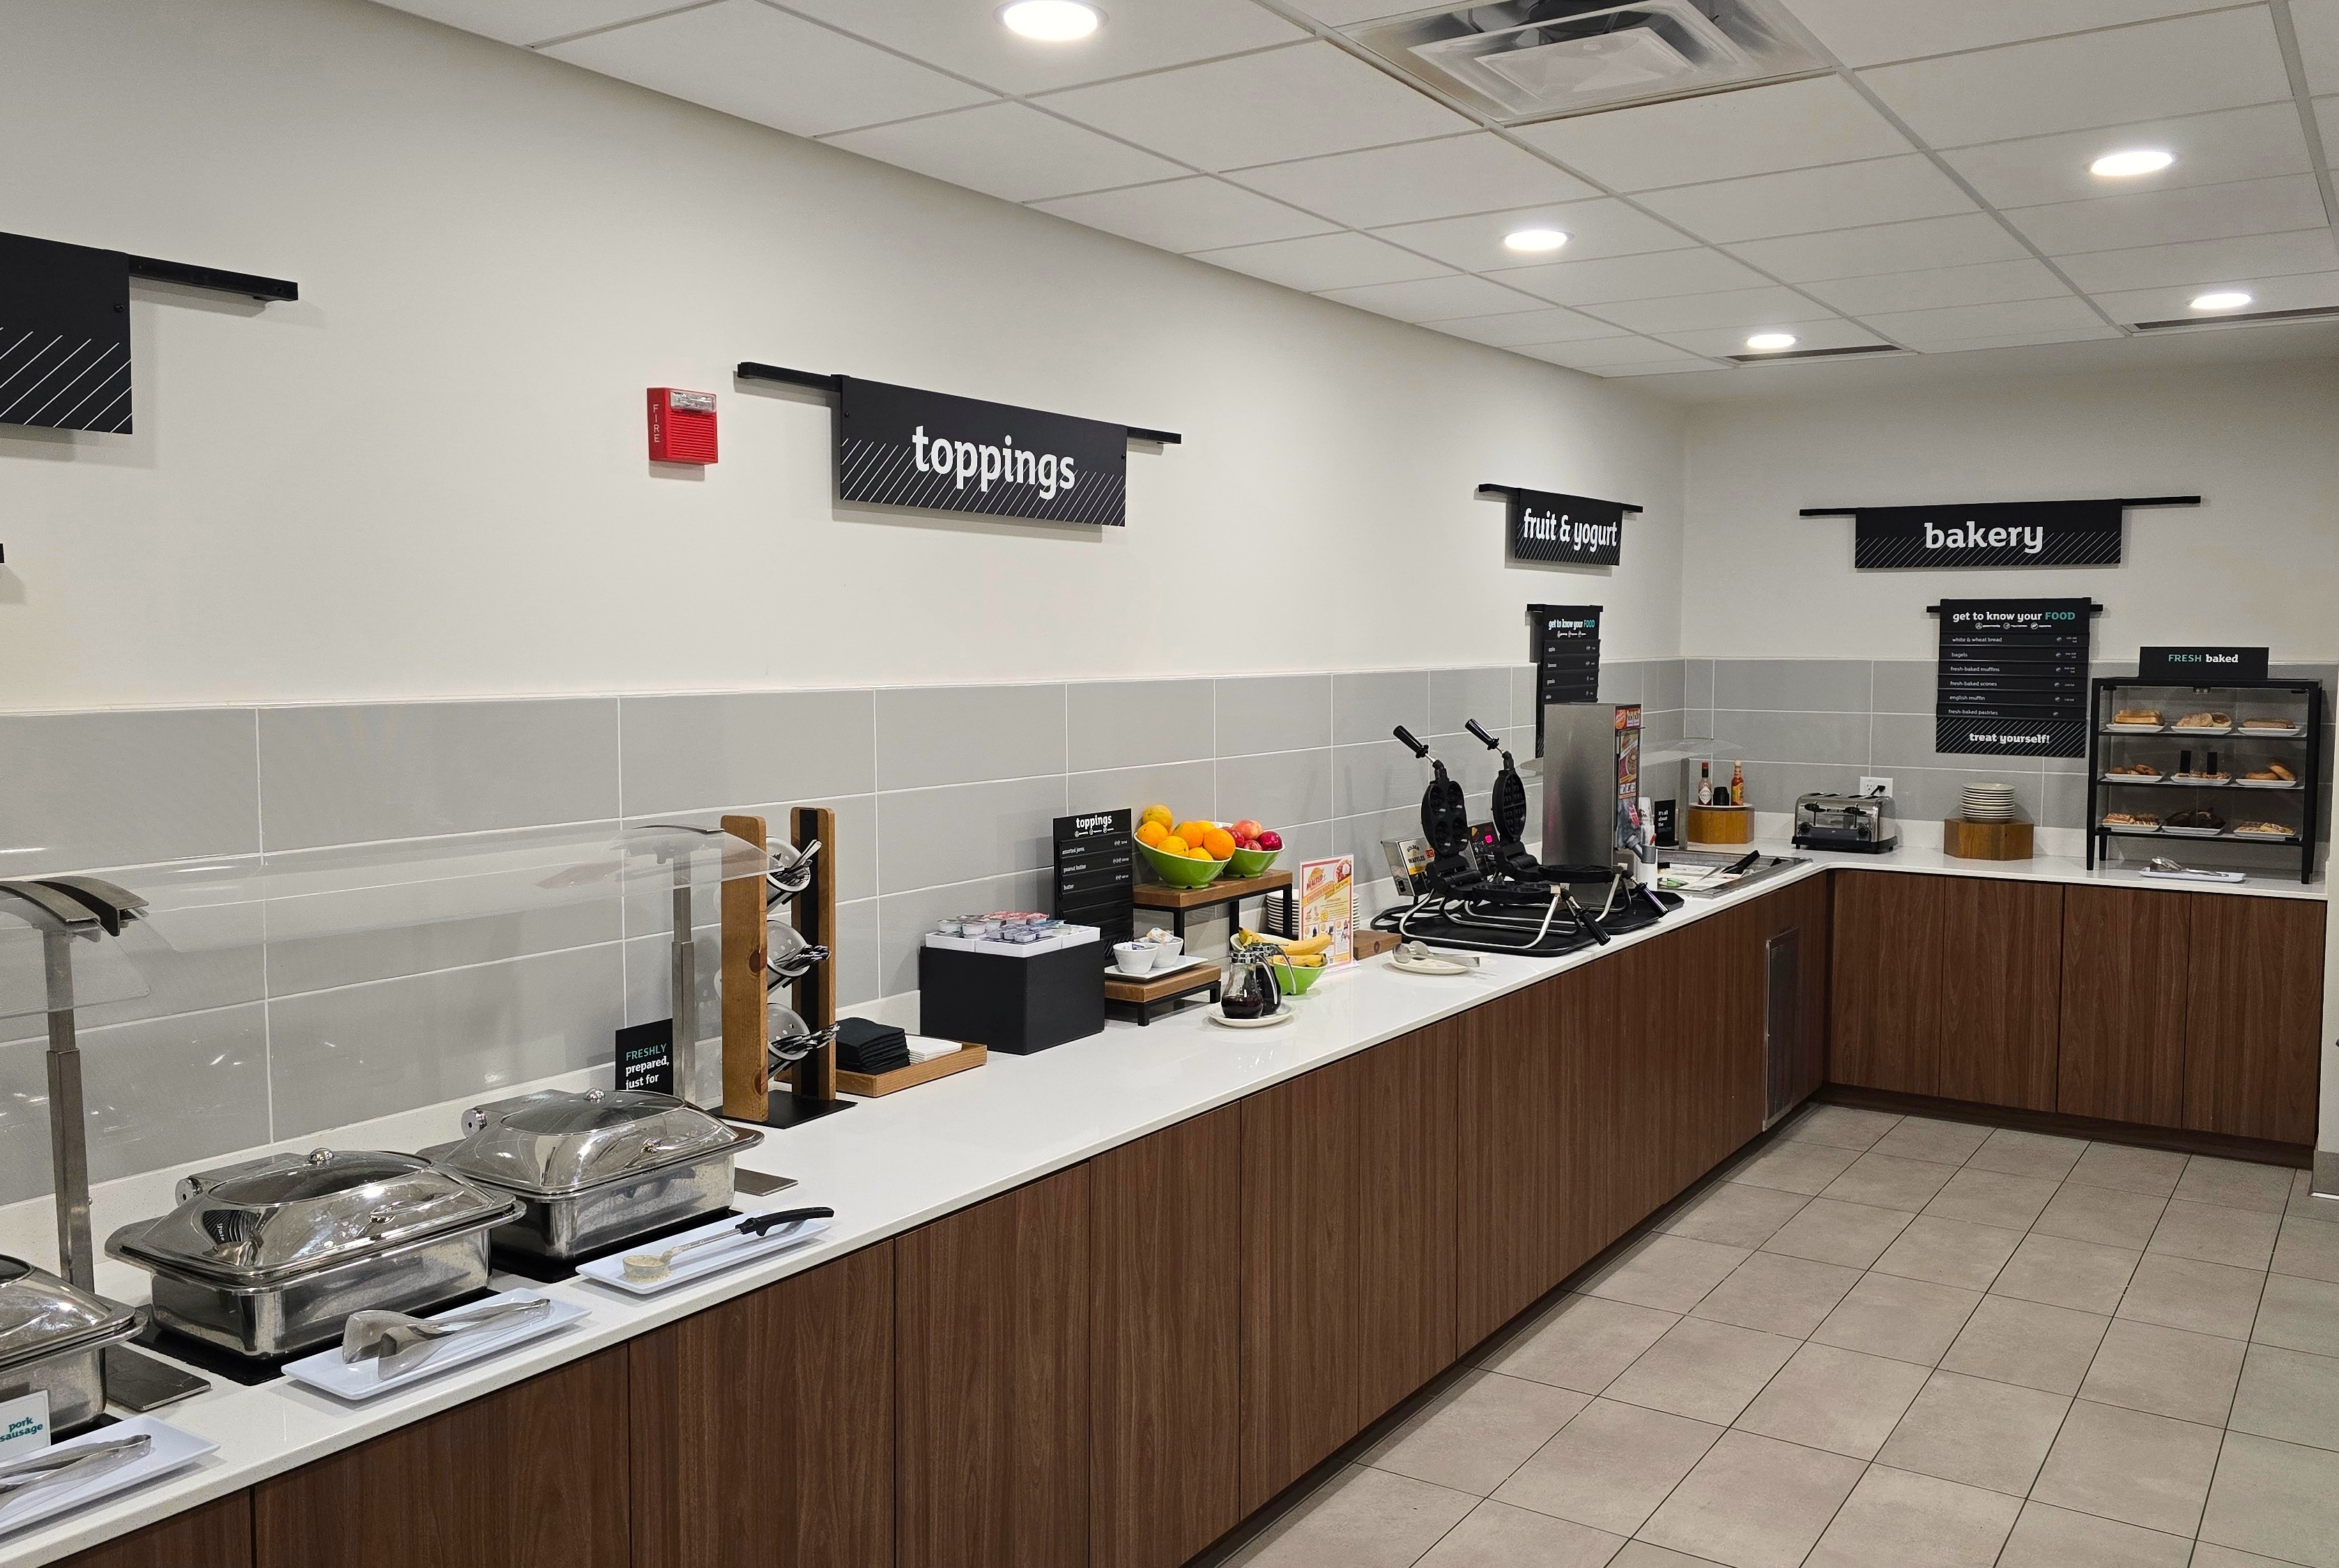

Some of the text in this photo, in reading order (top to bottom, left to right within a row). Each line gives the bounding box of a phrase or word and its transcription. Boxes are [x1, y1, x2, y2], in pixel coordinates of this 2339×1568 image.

[912, 425, 1075, 500] toppings
[1524, 508, 1617, 552] fruit & yogurt
[1924, 521, 2043, 554] bakery
[1584, 619, 1595, 628] FOOD
[1953, 612, 1971, 622] get
[1986, 612, 2015, 620] know
[2017, 612, 2042, 623] your
[2045, 612, 2076, 620] FOOD
[2168, 654, 2239, 663] FRESH baked
[1969, 733, 2050, 744] treat yourself!
[1076, 814, 1112, 830] toppings
[1408, 855, 1426, 864] WAFFLES
[626, 1044, 667, 1061] FRESHLY
[626, 1055, 669, 1076] prepared,
[626, 1074, 659, 1090] just for
[0, 1423, 43, 1442] sausage
[9, 1417, 33, 1432] pork
